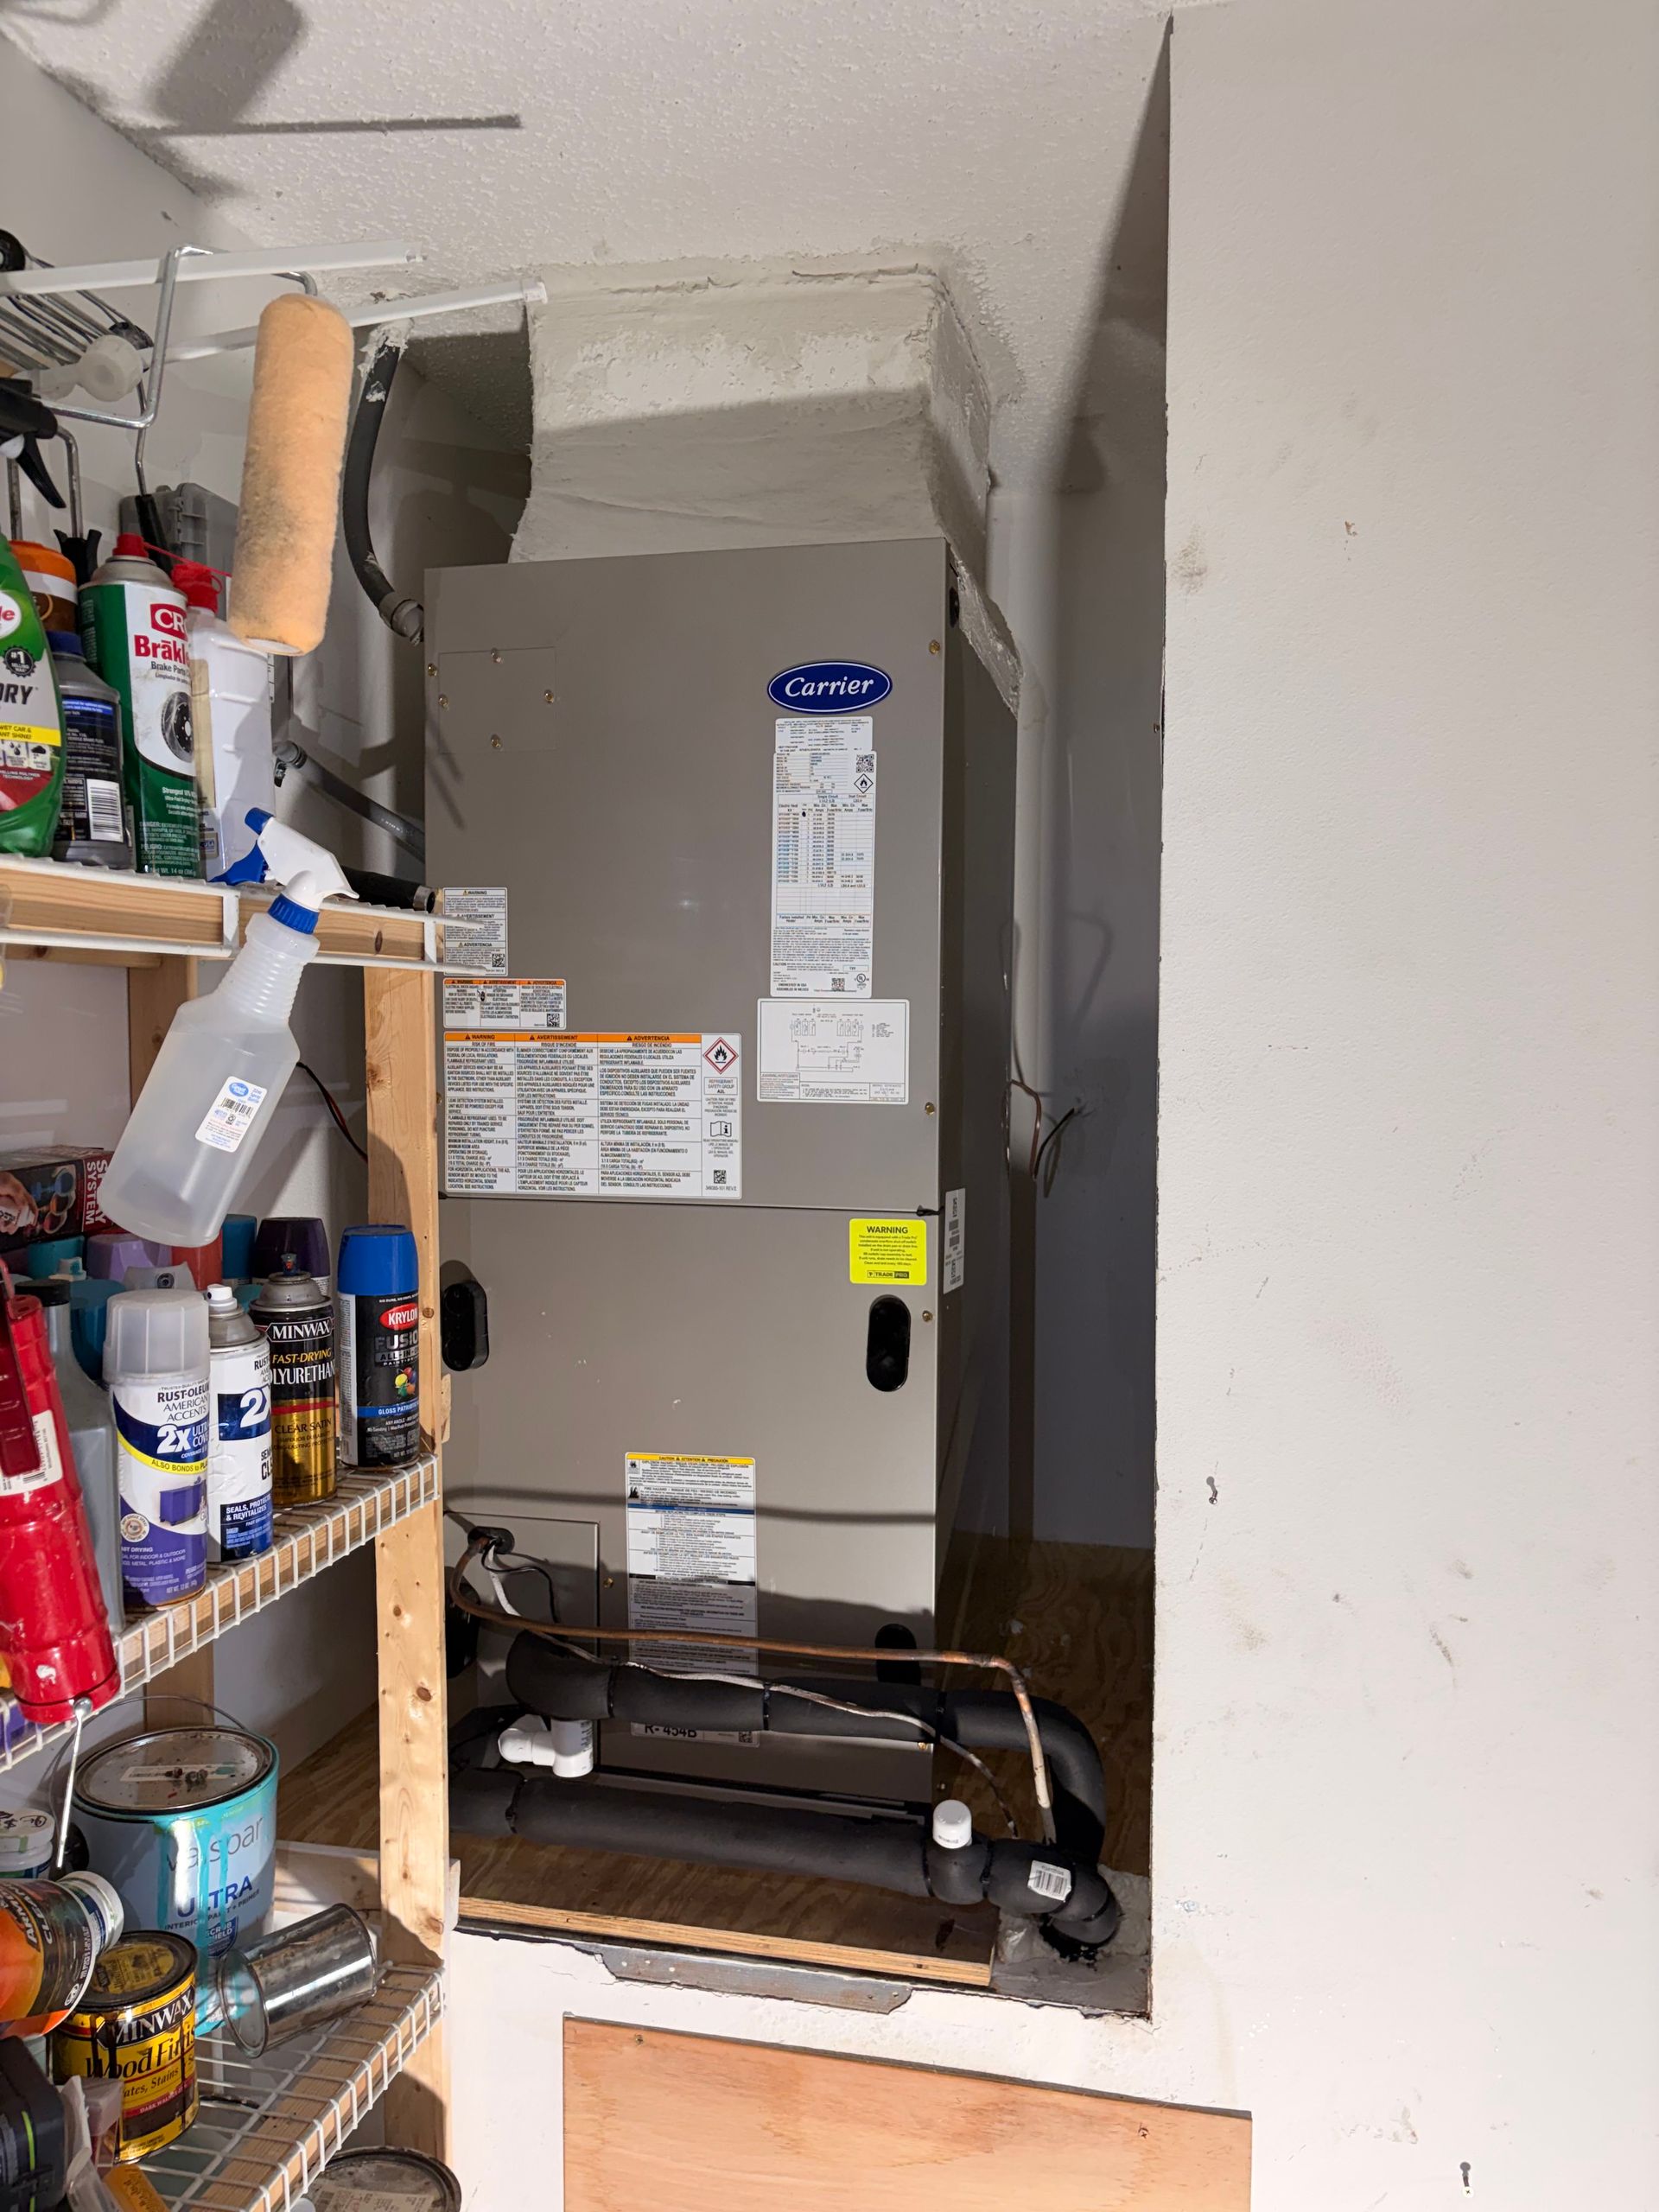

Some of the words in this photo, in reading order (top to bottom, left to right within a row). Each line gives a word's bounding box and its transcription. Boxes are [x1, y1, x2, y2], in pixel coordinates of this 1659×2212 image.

[155, 608, 187, 634] CR
[151, 661, 172, 671] Brake
[785, 677, 874, 697] Carrier
[86, 1161, 97, 1225] SYSTEM
[272, 1319, 330, 1339] MINWAX
[272, 1348, 332, 1363] FAST-DRYING
[167, 1406, 207, 1422] ACCENTS
[275, 1422, 308, 1434] CLEAR
[309, 1418, 332, 1428] SATIN
[151, 1459, 170, 1470] ALSO
[226, 1504, 248, 1514] SEALS,
[233, 1504, 267, 1520] REVITALIZES
[150, 2067, 179, 2089] Stains
[139, 2102, 156, 2113] DARK
